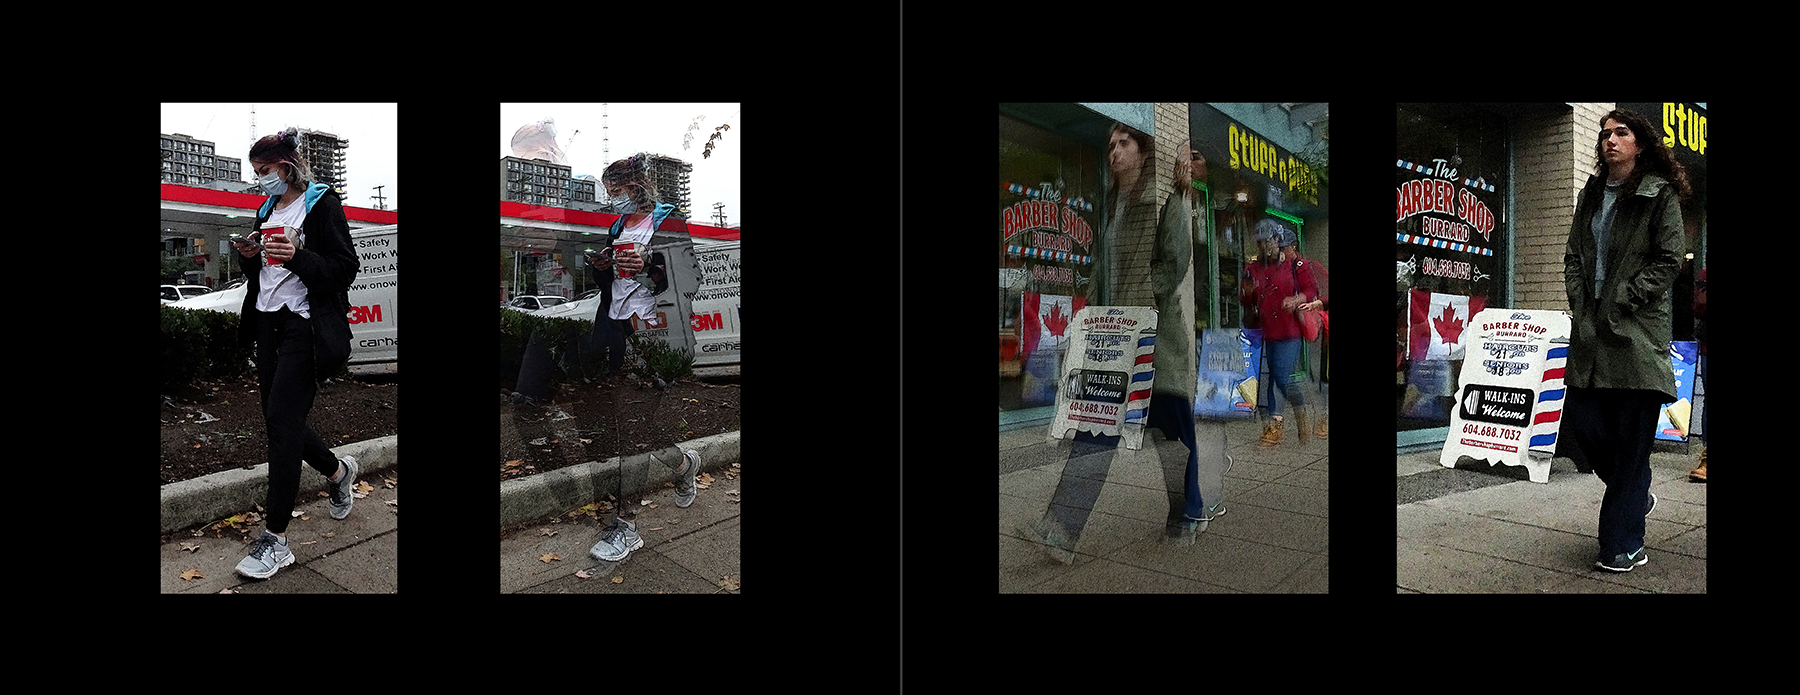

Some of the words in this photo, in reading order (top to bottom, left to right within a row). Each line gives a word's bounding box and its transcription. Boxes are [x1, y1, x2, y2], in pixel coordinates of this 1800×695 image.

[1432, 158, 1459, 183] The
[1040, 182, 1061, 202] The
[1458, 187, 1494, 242] SHOP
[1003, 200, 1059, 244] BARBER
[1062, 206, 1093, 254] SHOP
[1423, 216, 1470, 242] BURRARD
[360, 239, 390, 248] Safety
[361, 252, 387, 261] Work
[702, 254, 730, 262] Safety
[364, 265, 386, 274] First
[704, 265, 728, 274] Work
[348, 304, 383, 325] 3M
[691, 312, 723, 332] 3M
[1084, 317, 1115, 325] BARBER
[1116, 318, 1138, 327] SHOP
[1483, 322, 1520, 331] BARBER
[1522, 323, 1547, 335] SHOP
[1483, 342, 1539, 353] HAIRCUTS
[1087, 374, 1122, 386] WALK-INS
[1085, 386, 1122, 398] Welcome
[1484, 390, 1527, 405] WALK-INS
[1070, 402, 1118, 415] 604.688.7032
[1481, 404, 1526, 420] Welcome
[1463, 423, 1521, 441] 604.688.7032
